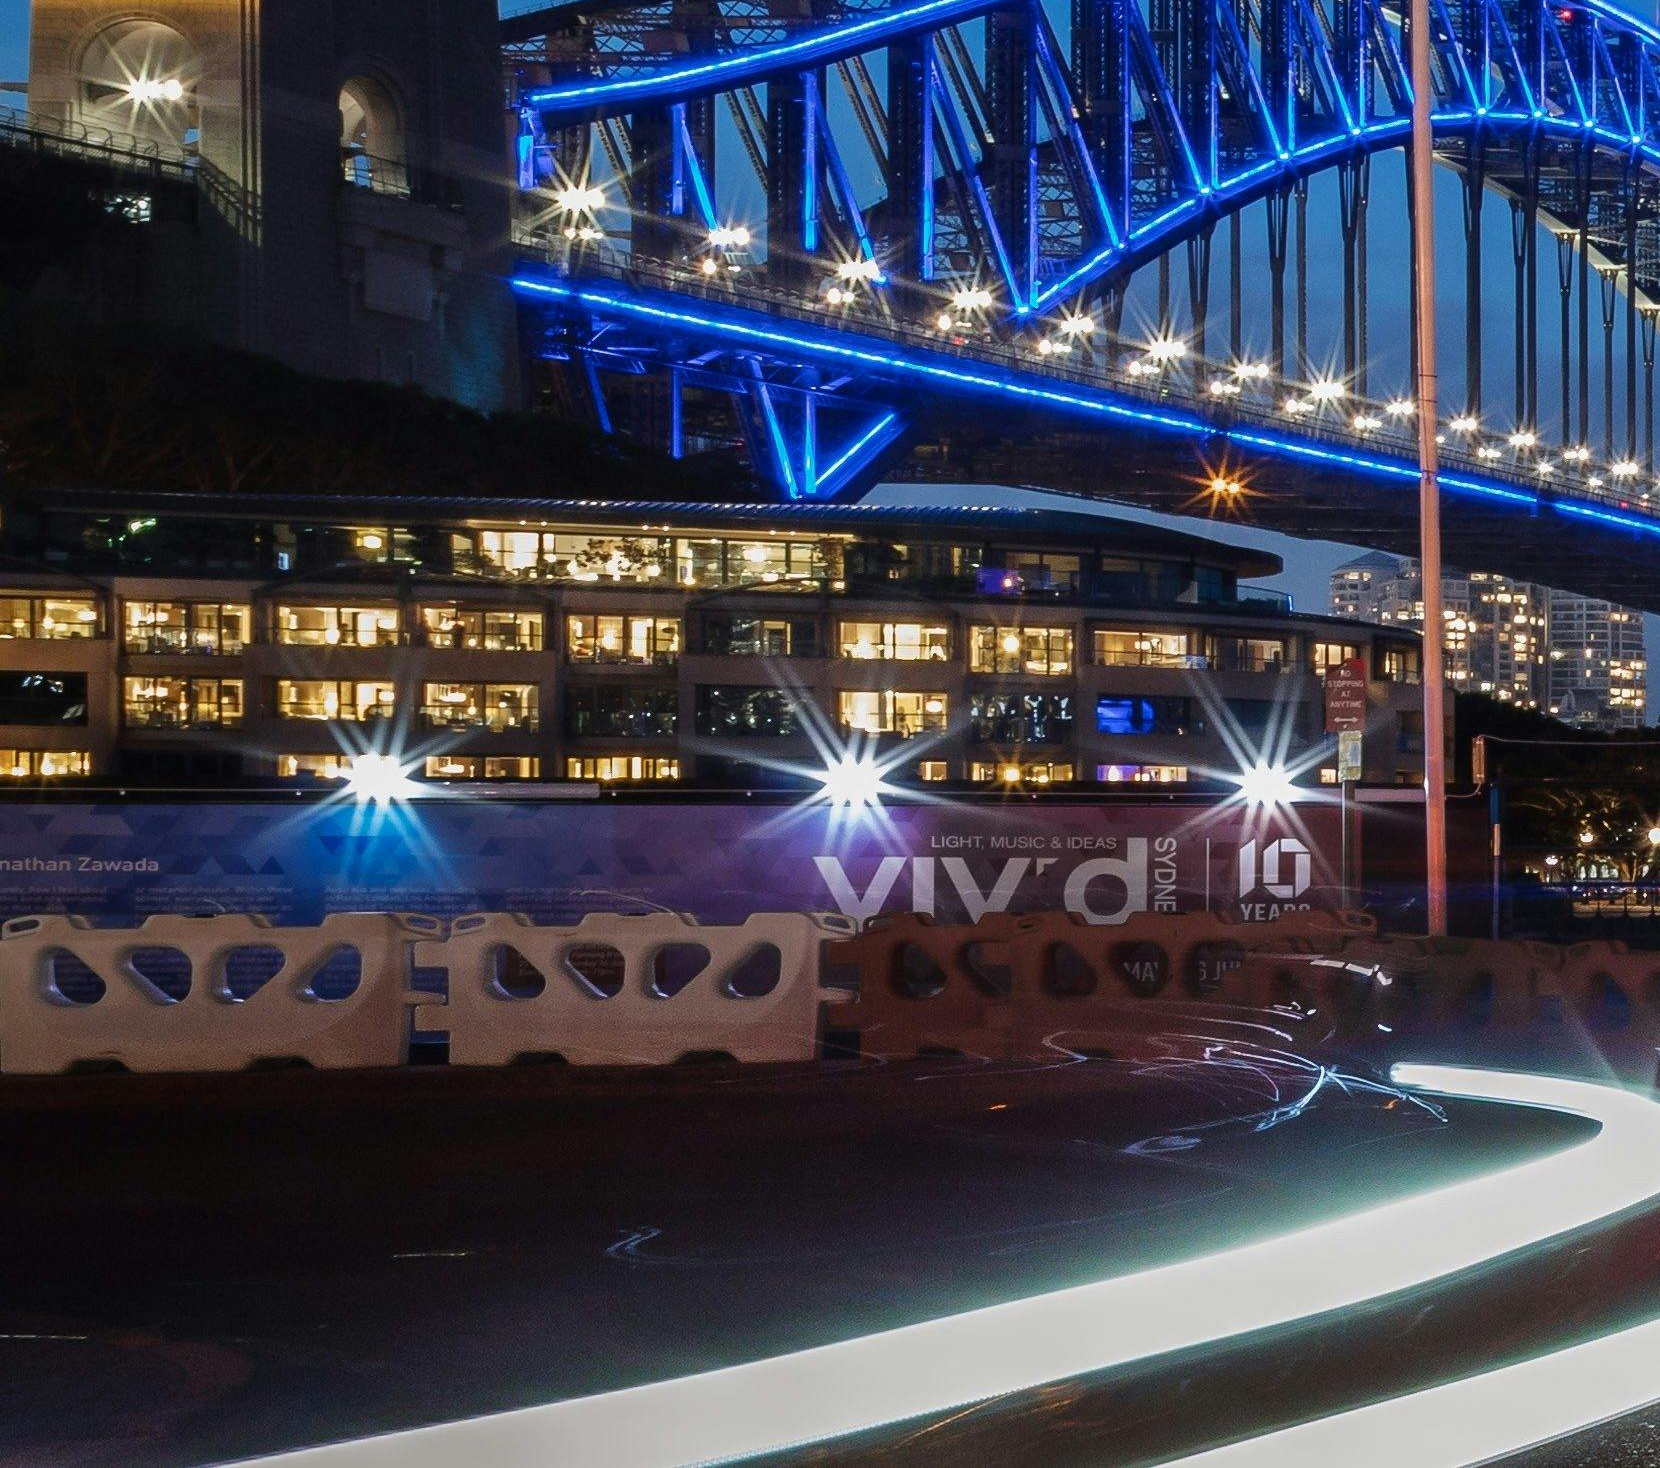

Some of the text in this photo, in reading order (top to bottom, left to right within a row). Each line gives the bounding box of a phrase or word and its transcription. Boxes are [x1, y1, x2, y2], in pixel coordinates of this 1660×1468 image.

[931, 835, 1117, 850] LIGHT, MUSIC & IDEAS
[78, 855, 160, 872] Zawada
[1239, 838, 1312, 899] 10
[1154, 837, 1177, 913] SYDNE
[1123, 961, 1159, 982] MA
